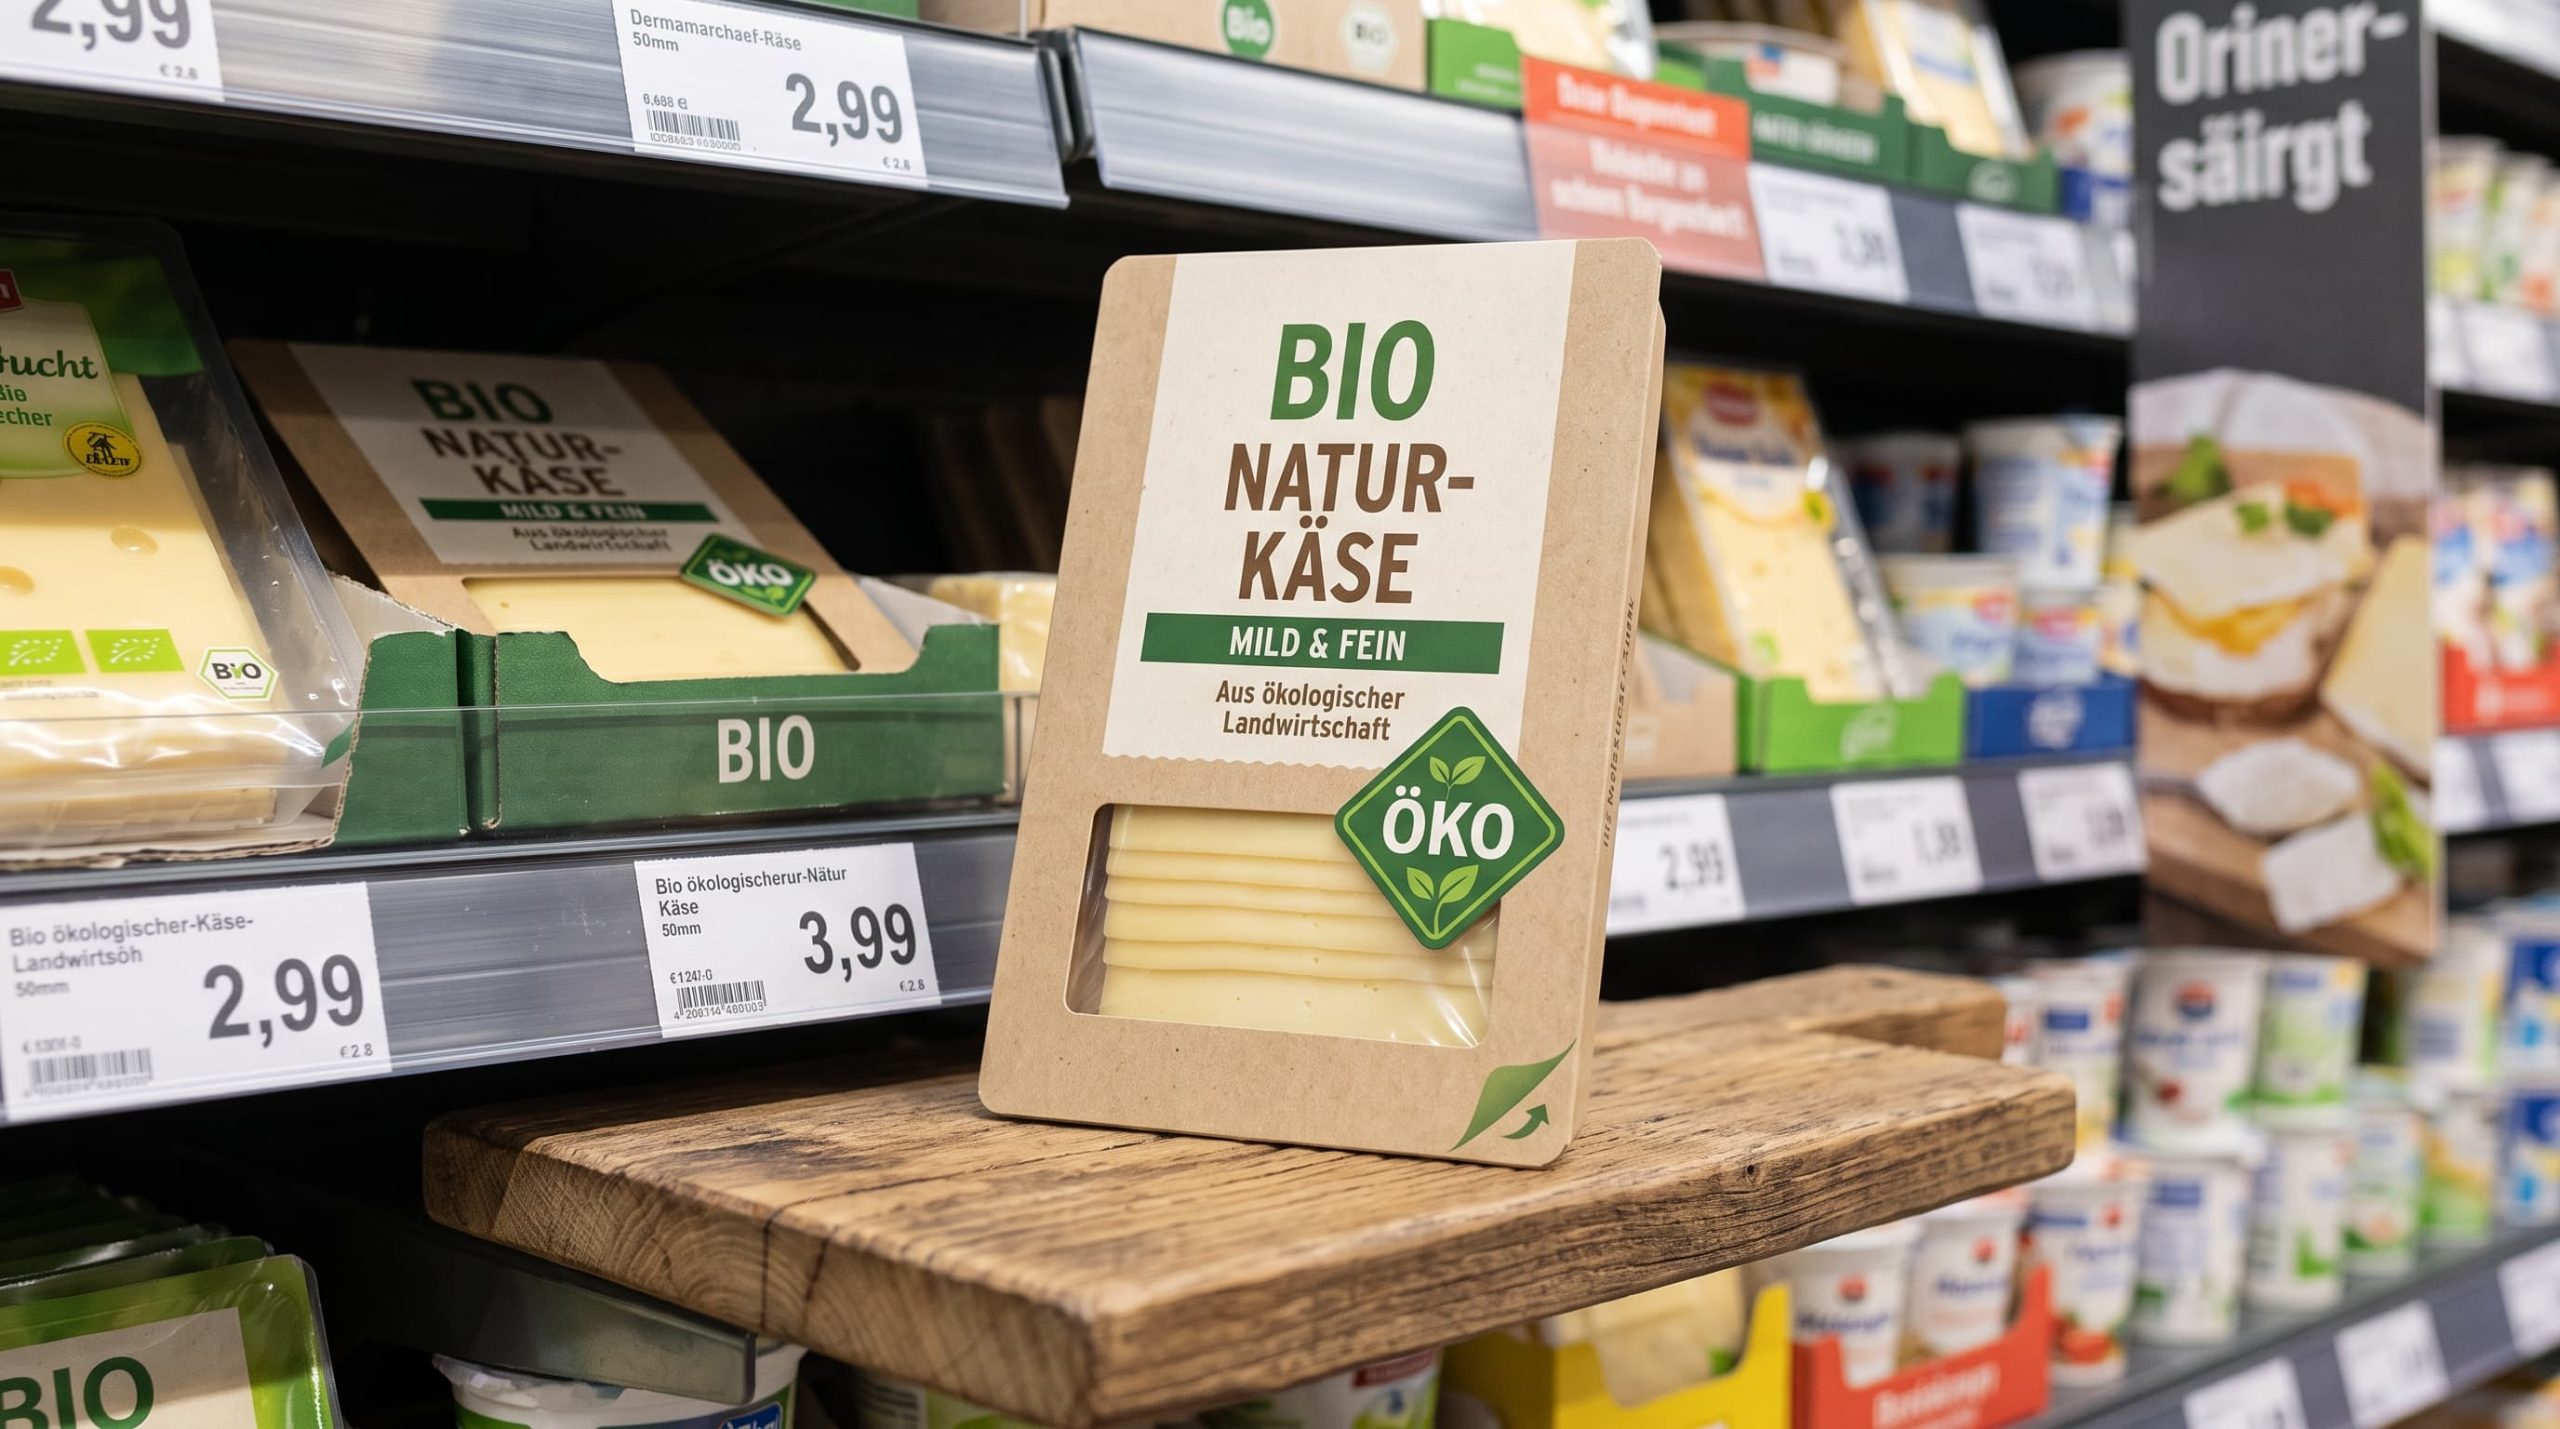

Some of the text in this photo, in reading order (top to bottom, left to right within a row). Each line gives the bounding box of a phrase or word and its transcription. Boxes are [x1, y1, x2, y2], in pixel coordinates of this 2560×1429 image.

[630, 9, 802, 51] Dermamarchaef-Räse
[633, 31, 679, 51] 50mm
[786, 73, 902, 148] 2,99
[1270, 320, 1435, 421] BIO
[411, 379, 553, 423] BIO
[421, 428, 622, 462] NATUR-
[472, 458, 625, 496] KÄSE
[1224, 443, 1474, 513] NATUR-
[500, 503, 562, 519] MILD
[590, 504, 648, 520] FEIN
[706, 558, 794, 588] ÖKO
[1238, 515, 1418, 604] KÄSE
[1229, 626, 1406, 661] MILD & FEIN
[1216, 680, 1405, 712] Aus ökologischer
[1223, 711, 1390, 740] Landwirtschaft
[718, 715, 815, 783] BIO
[1382, 786, 1514, 860] ÖKO
[656, 866, 847, 894] Bio ökologischerur-Nätur
[659, 900, 699, 917] Käse
[10, 912, 254, 947] Bio ökologischer-Käse-
[662, 922, 701, 937] 50mm
[799, 903, 916, 982] 3,99
[13, 947, 143, 973] Landwirtsöh
[15, 980, 70, 997] 50mm
[204, 954, 364, 1048] 2,99
[0, 1357, 155, 1429] BIO
